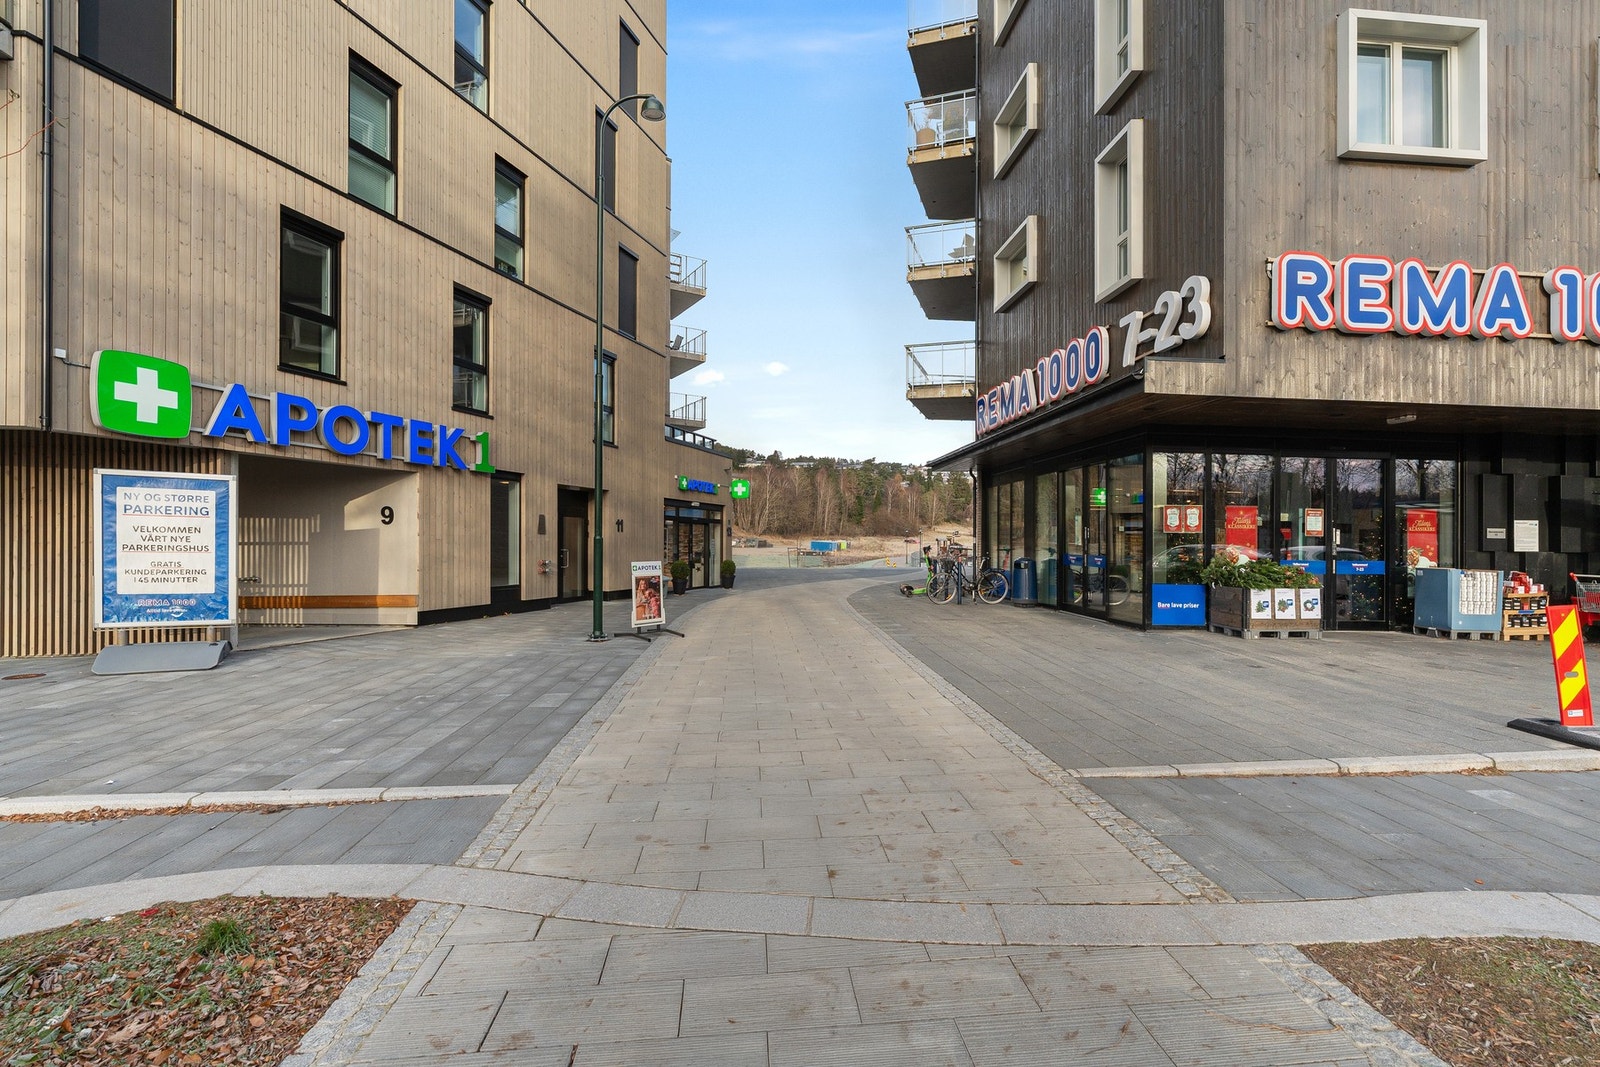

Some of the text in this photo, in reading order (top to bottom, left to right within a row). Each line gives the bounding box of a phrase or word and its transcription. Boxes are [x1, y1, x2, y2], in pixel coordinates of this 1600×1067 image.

[1271, 250, 1534, 339] REMA
[1119, 275, 1211, 368] 7-23
[976, 325, 1110, 436] REMA 1000
[202, 383, 496, 474] APOTEK 1
[688, 479, 714, 494] APOTEK
[123, 492, 210, 503] NY OG STØRRE
[123, 504, 210, 516] PARKERING
[380, 505, 395, 525] 9
[132, 525, 202, 534] VELKOMMEN
[615, 519, 624, 533] 11
[141, 534, 168, 543] VÅRT
[122, 543, 210, 552] PARKERINGSHUS
